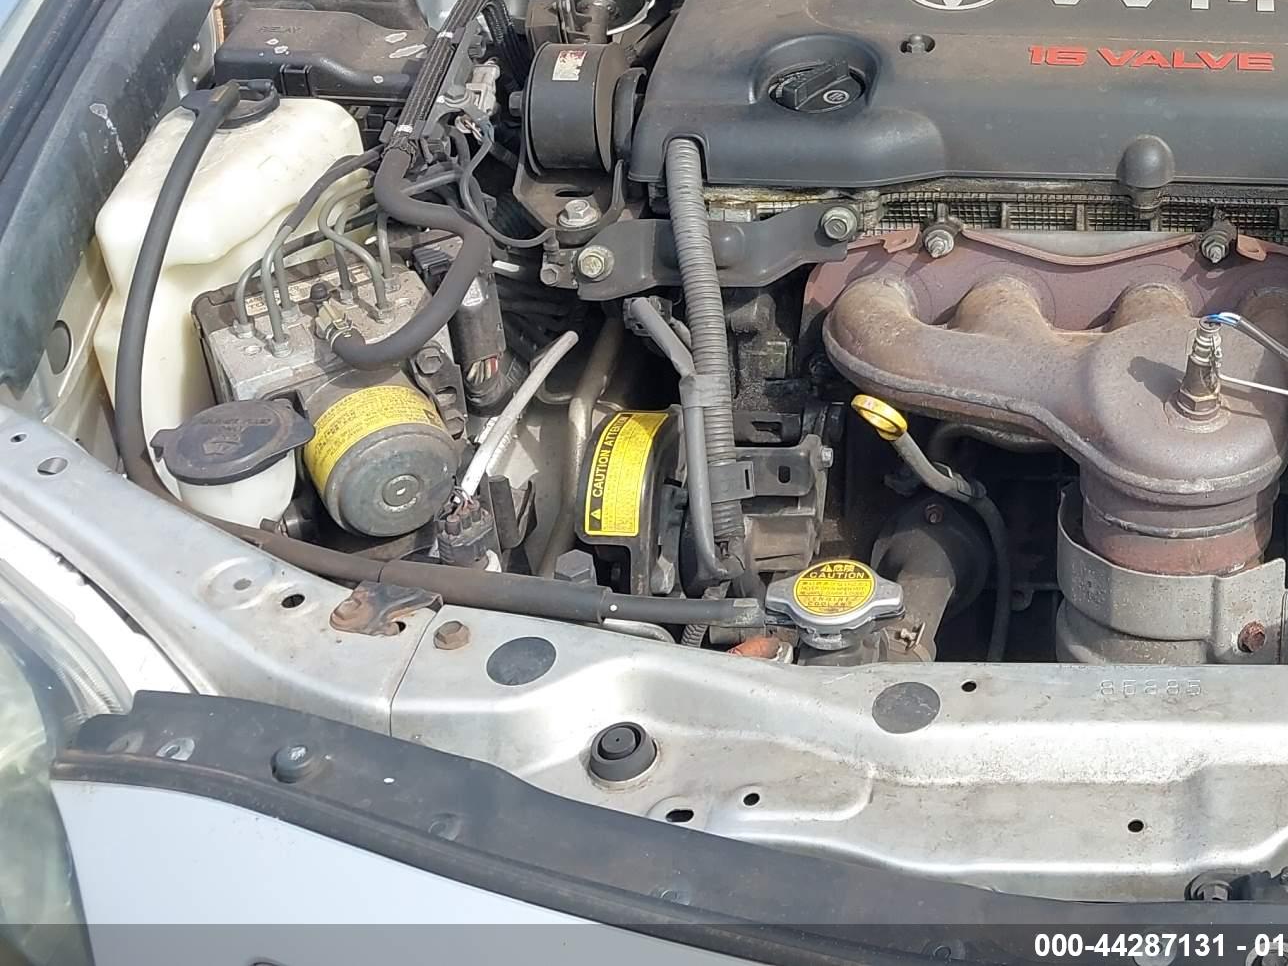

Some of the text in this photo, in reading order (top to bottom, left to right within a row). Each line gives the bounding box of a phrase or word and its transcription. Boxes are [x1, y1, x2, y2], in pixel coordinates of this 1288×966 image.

[1028, 45, 1275, 71] 16 VALVE
[592, 453, 611, 498] CAUTION
